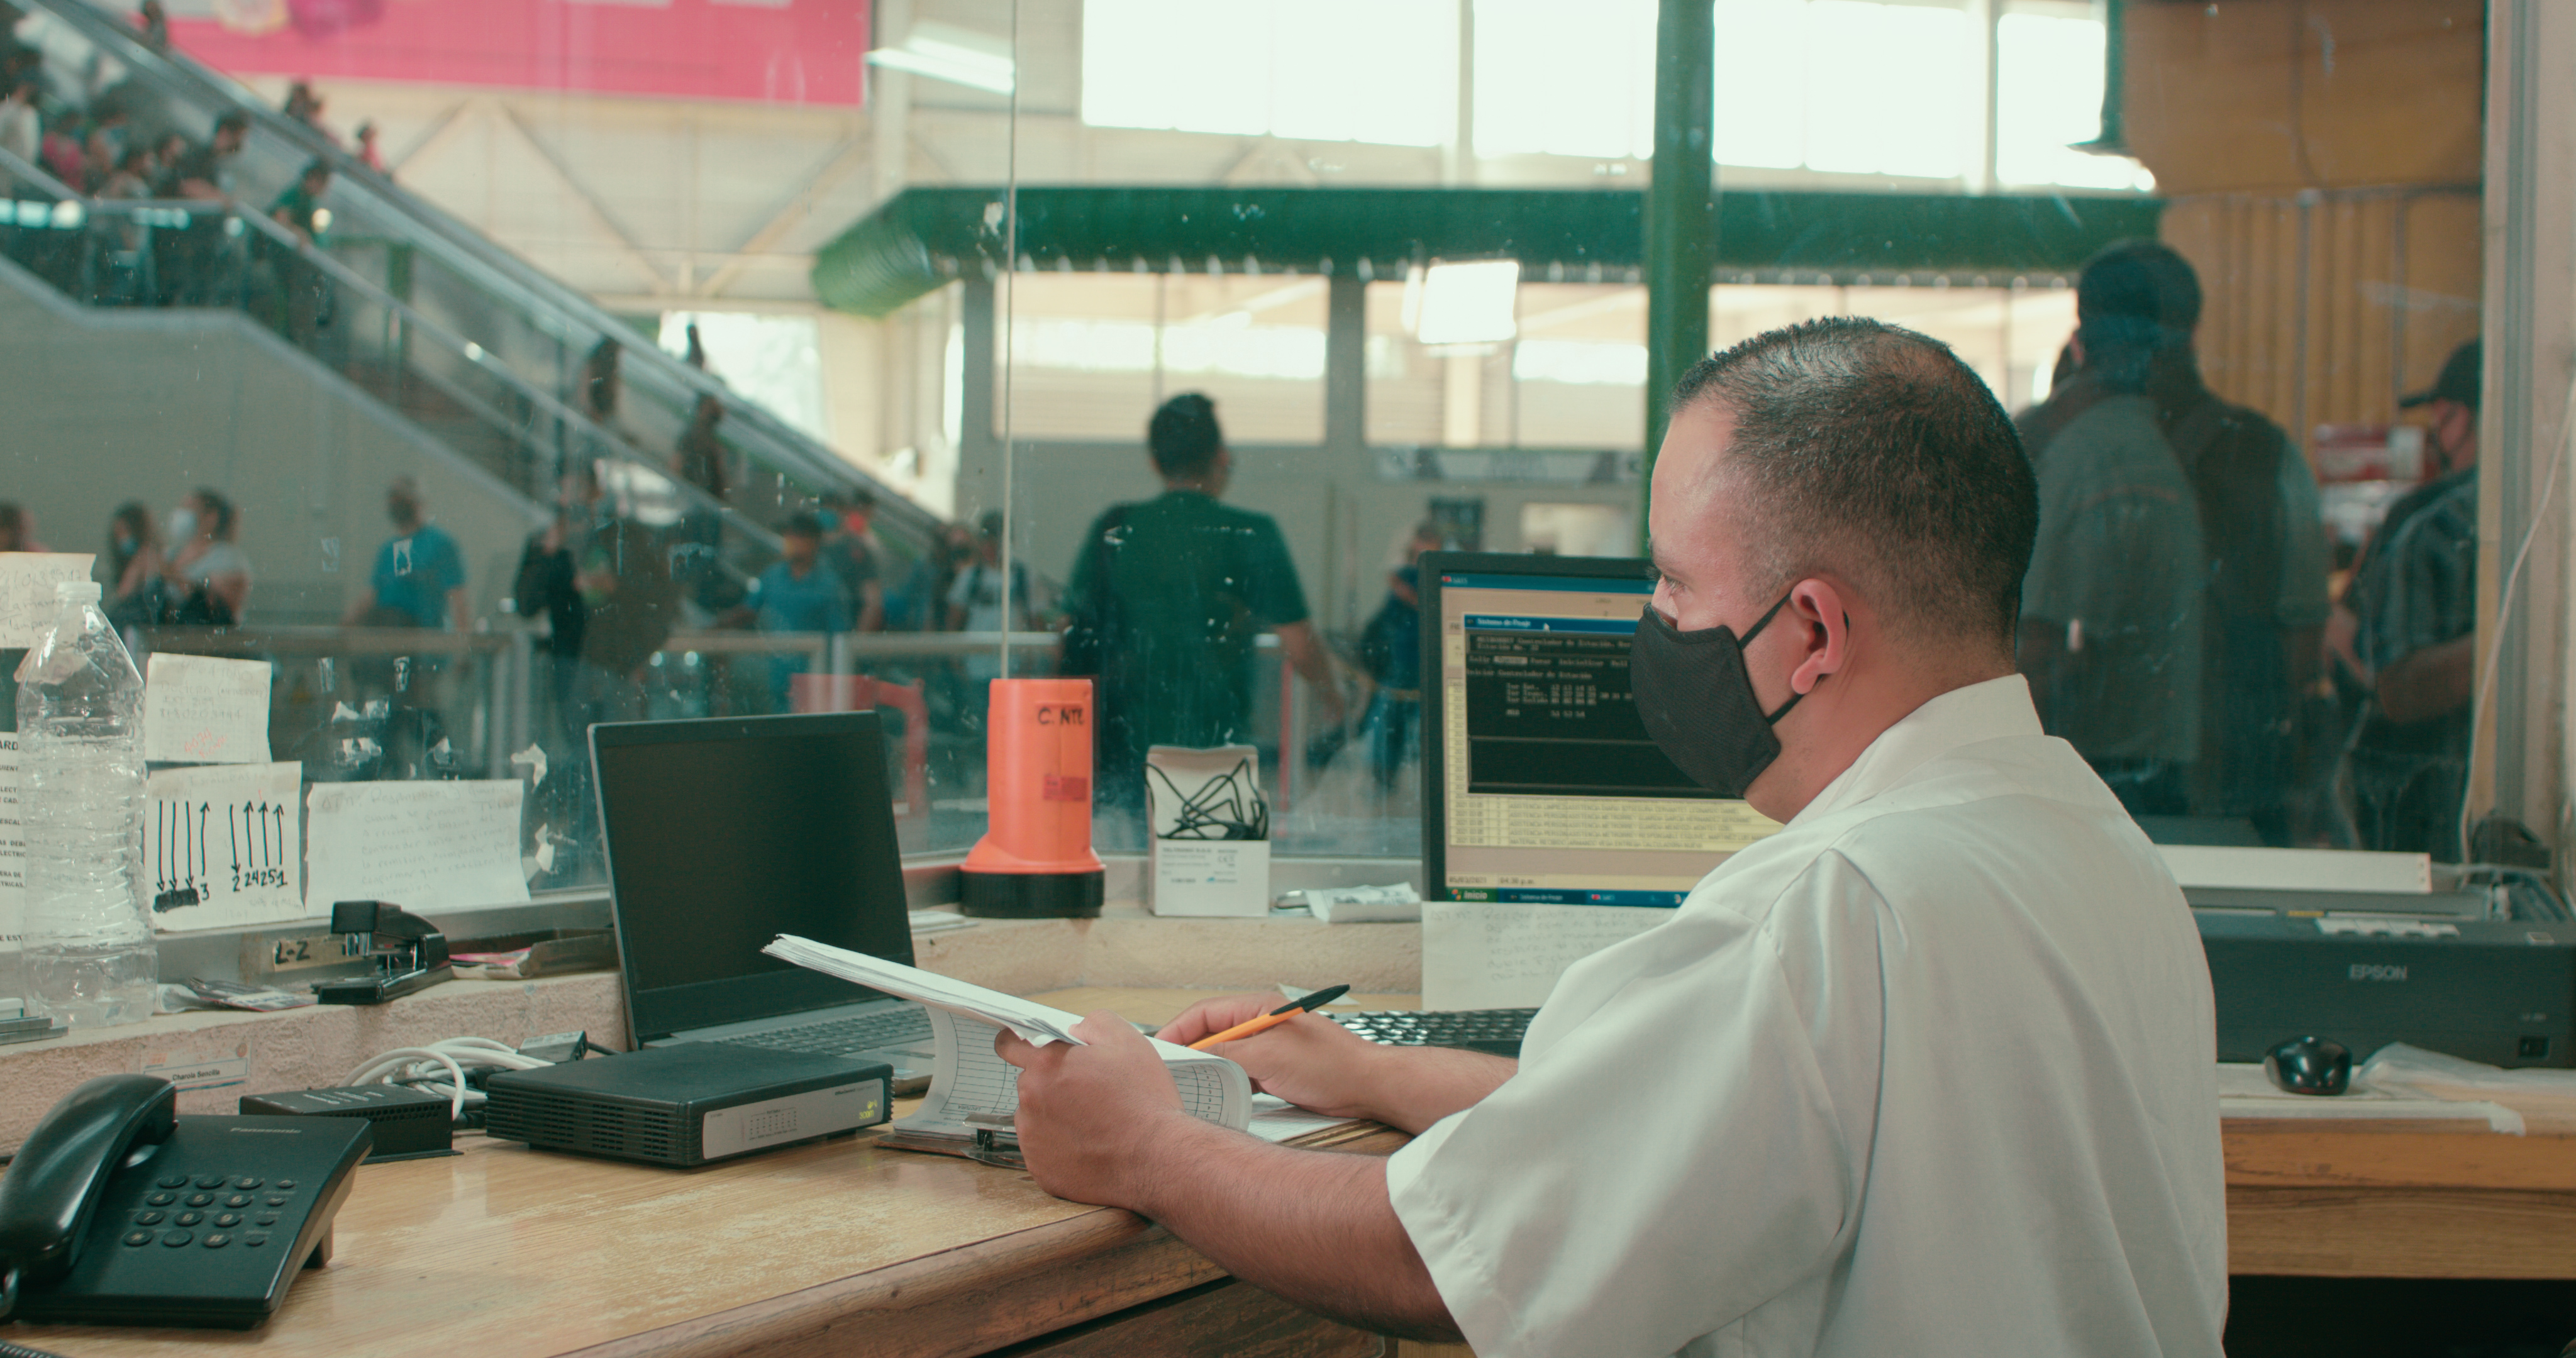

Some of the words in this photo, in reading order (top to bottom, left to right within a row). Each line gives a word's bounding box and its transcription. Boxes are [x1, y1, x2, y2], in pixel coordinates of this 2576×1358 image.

[1497, 670, 1544, 678] Controlador
[1546, 670, 1555, 678] de
[231, 873, 242, 893] 2
[245, 870, 260, 888] 24
[260, 869, 277, 888] 25
[200, 881, 211, 902] 3
[1463, 890, 1487, 900] Inicio
[2349, 963, 2408, 981] EPSON
[172, 1072, 196, 1081] Charola
[197, 1068, 221, 1078] Sencilla
[154, 1193, 166, 1201] 4
[144, 1212, 157, 1221] 7
[221, 1213, 233, 1222] 9
